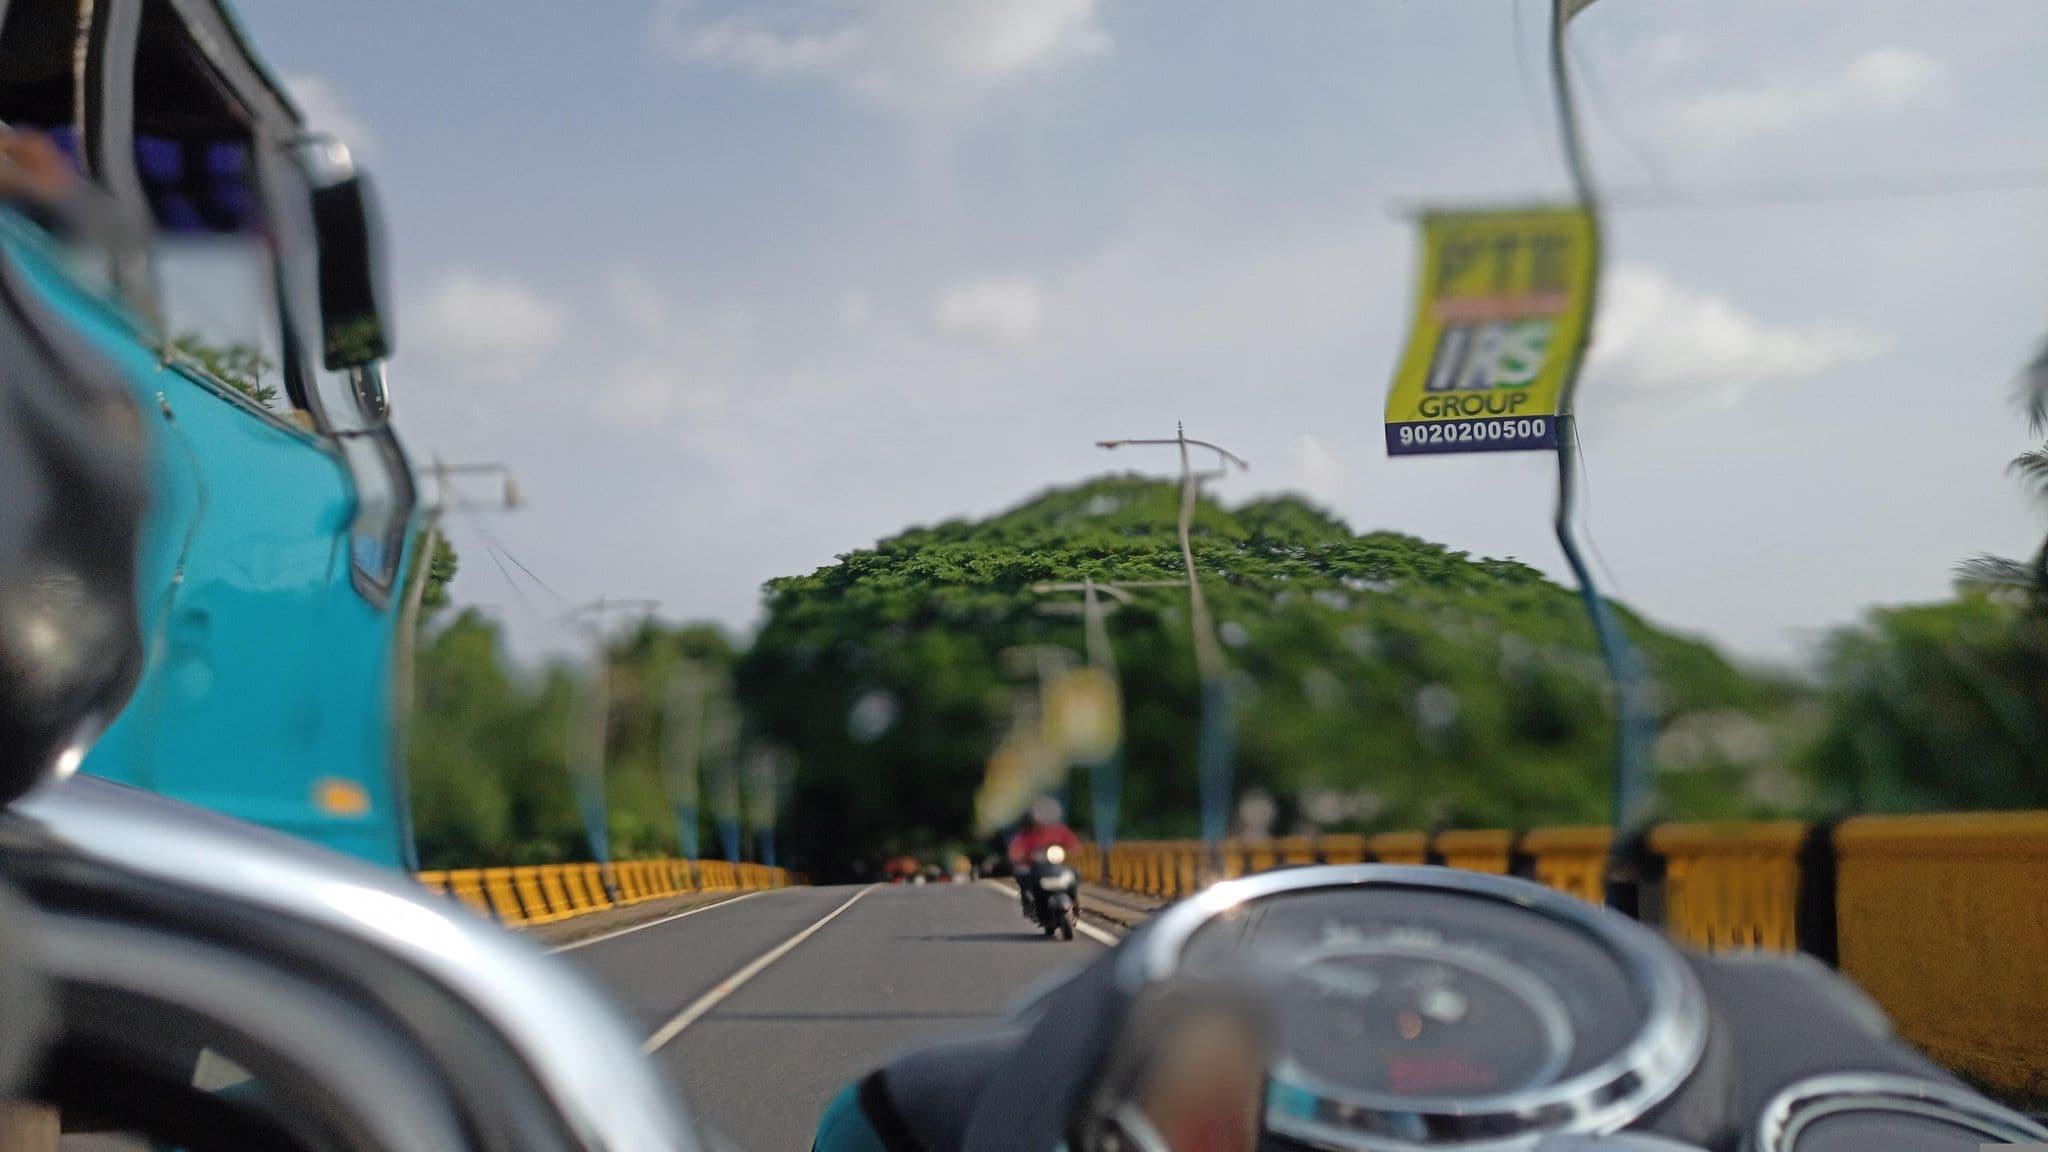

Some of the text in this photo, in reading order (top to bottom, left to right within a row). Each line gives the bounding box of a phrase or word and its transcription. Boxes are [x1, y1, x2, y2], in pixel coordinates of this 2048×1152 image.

[1425, 321, 1555, 391] IRS
[1418, 393, 1529, 418] GROUP
[1399, 419, 1547, 445] 9020200500
